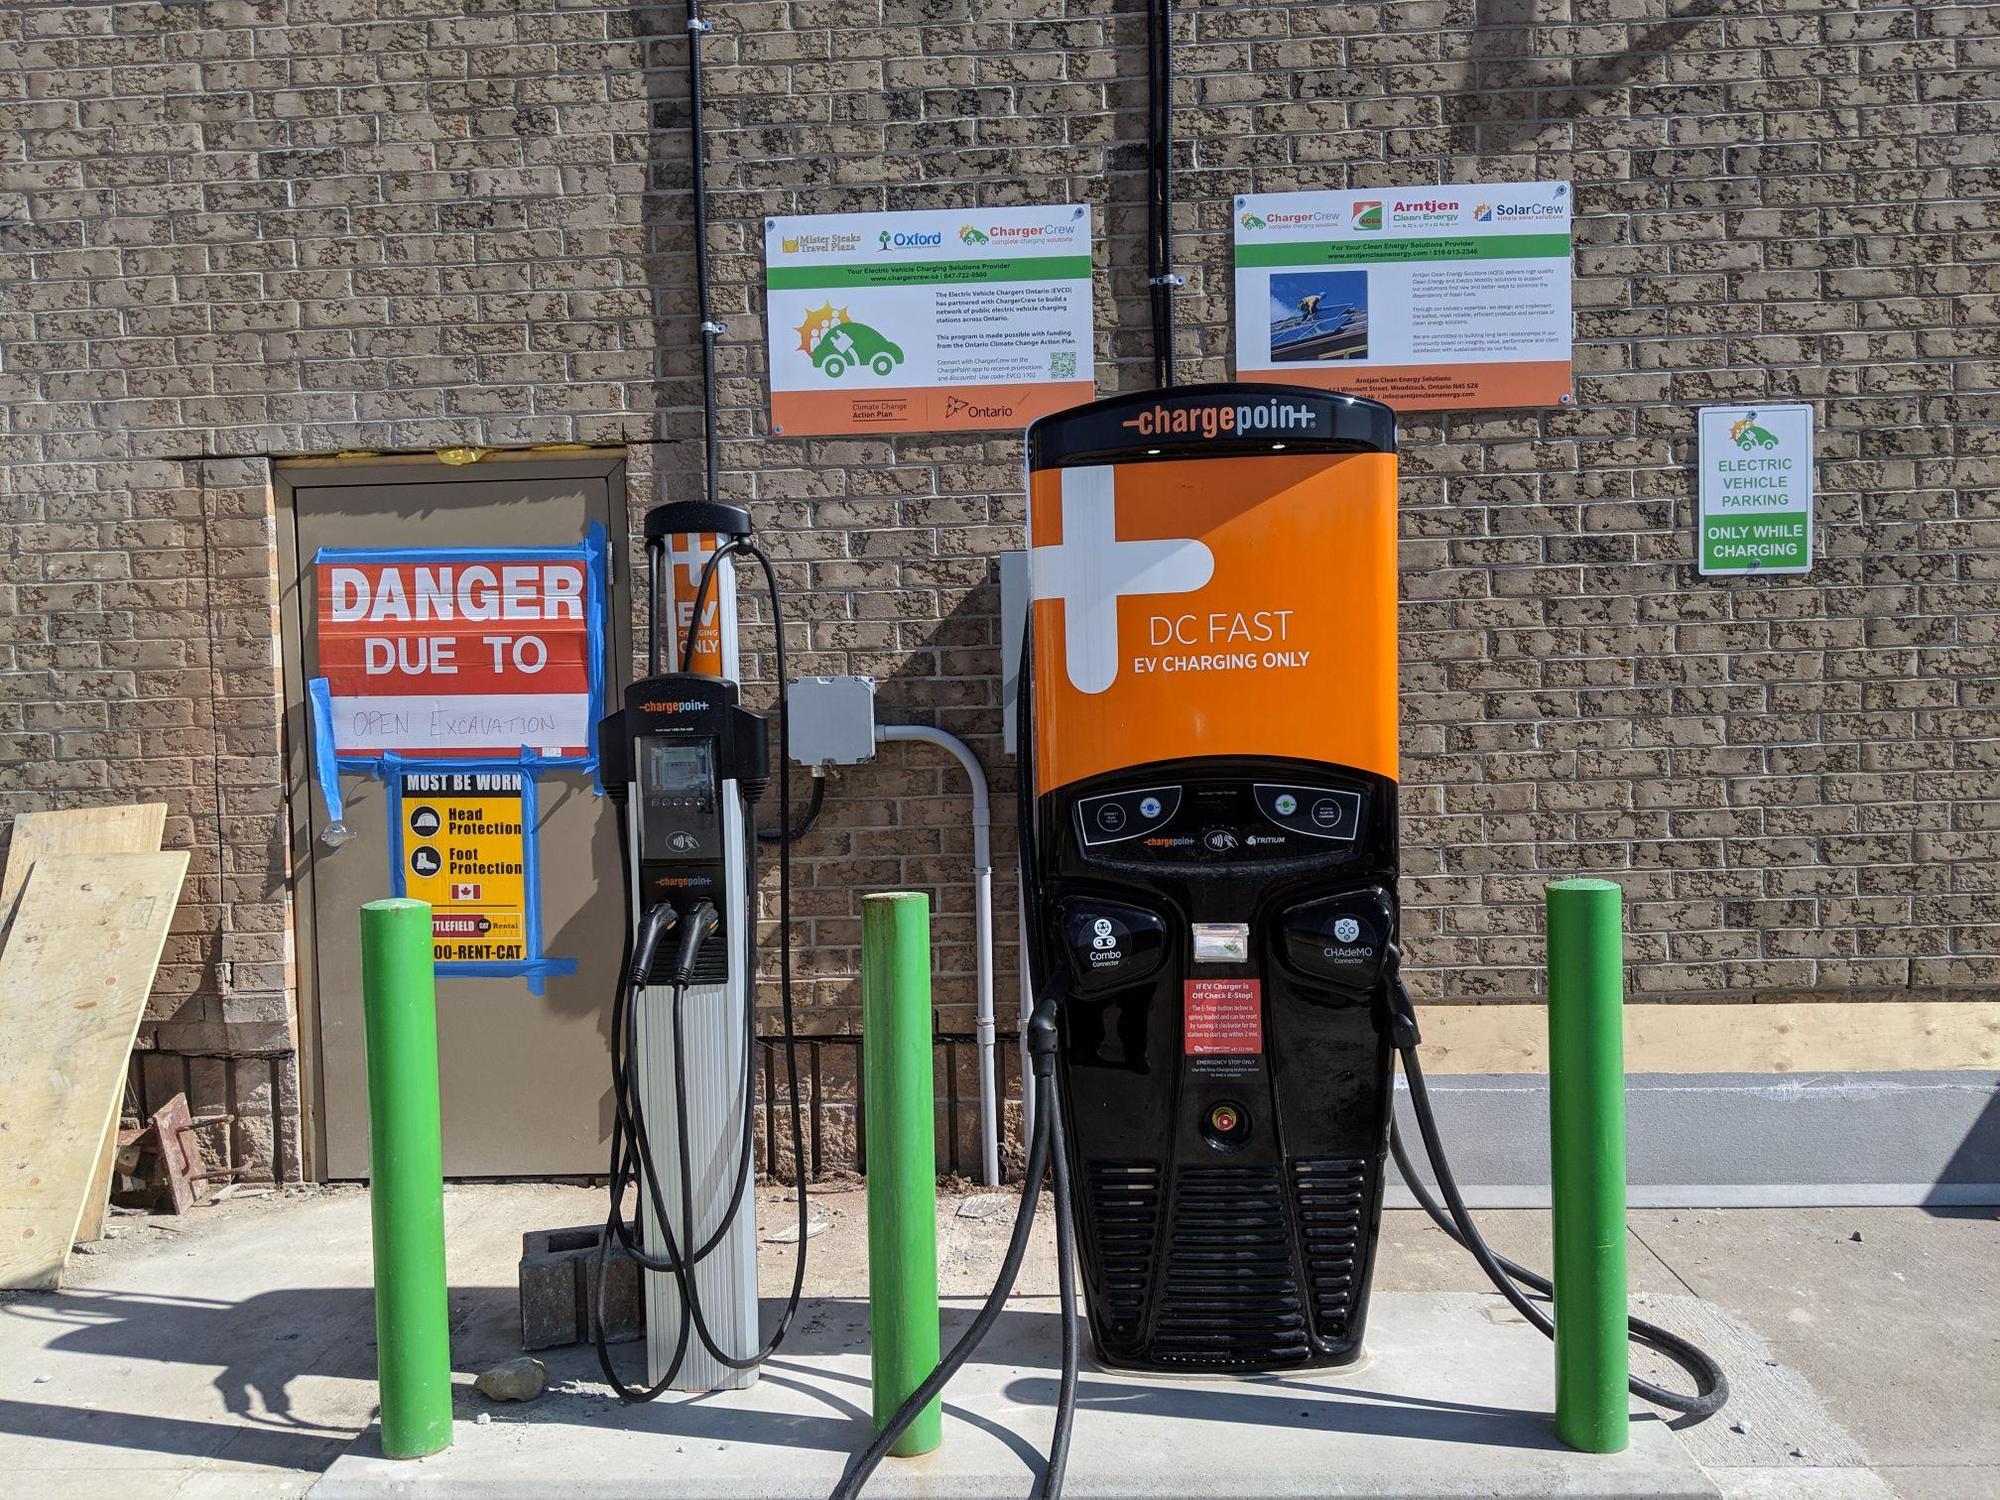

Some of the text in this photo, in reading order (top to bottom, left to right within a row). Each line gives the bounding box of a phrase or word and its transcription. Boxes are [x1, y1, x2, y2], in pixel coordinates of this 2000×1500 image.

[1394, 200, 1458, 212] Arntjen
[1497, 204, 1563, 216] SolarCrew
[1267, 211, 1341, 223] ChargerCrew
[1423, 213, 1458, 222] Energy
[990, 224, 1075, 237] ChargerCrew
[800, 235, 829, 244] Mister
[894, 232, 941, 246] Oxford
[800, 242, 856, 252] Travel Plaza
[881, 402, 907, 410] Change
[968, 406, 1013, 418] Ontario
[1718, 458, 1792, 472] ELECTRIC
[1723, 476, 1788, 489] VEHICLE
[1722, 493, 1789, 507] PARKING
[1708, 524, 1803, 540] ONLY WHILE
[1713, 543, 1798, 558] CHARGING
[331, 565, 585, 622] DANGER
[678, 602, 718, 627] EV
[1150, 610, 1293, 646] DC FAST
[364, 636, 548, 675] DUE TO
[1134, 651, 1310, 673] EV CHARGING ONLY
[352, 710, 409, 737] OPEN
[407, 775, 521, 791] MUST BE WORN
[448, 808, 482, 821] Head
[449, 822, 521, 835] Protection
[450, 848, 478, 860] Foot
[450, 862, 522, 875] Protection
[432, 921, 474, 932] TLEFIELD
[434, 945, 521, 960] 00-RENT-CAT
[1090, 950, 1121, 961] Combo
[1324, 947, 1372, 957] CHAdeMO
